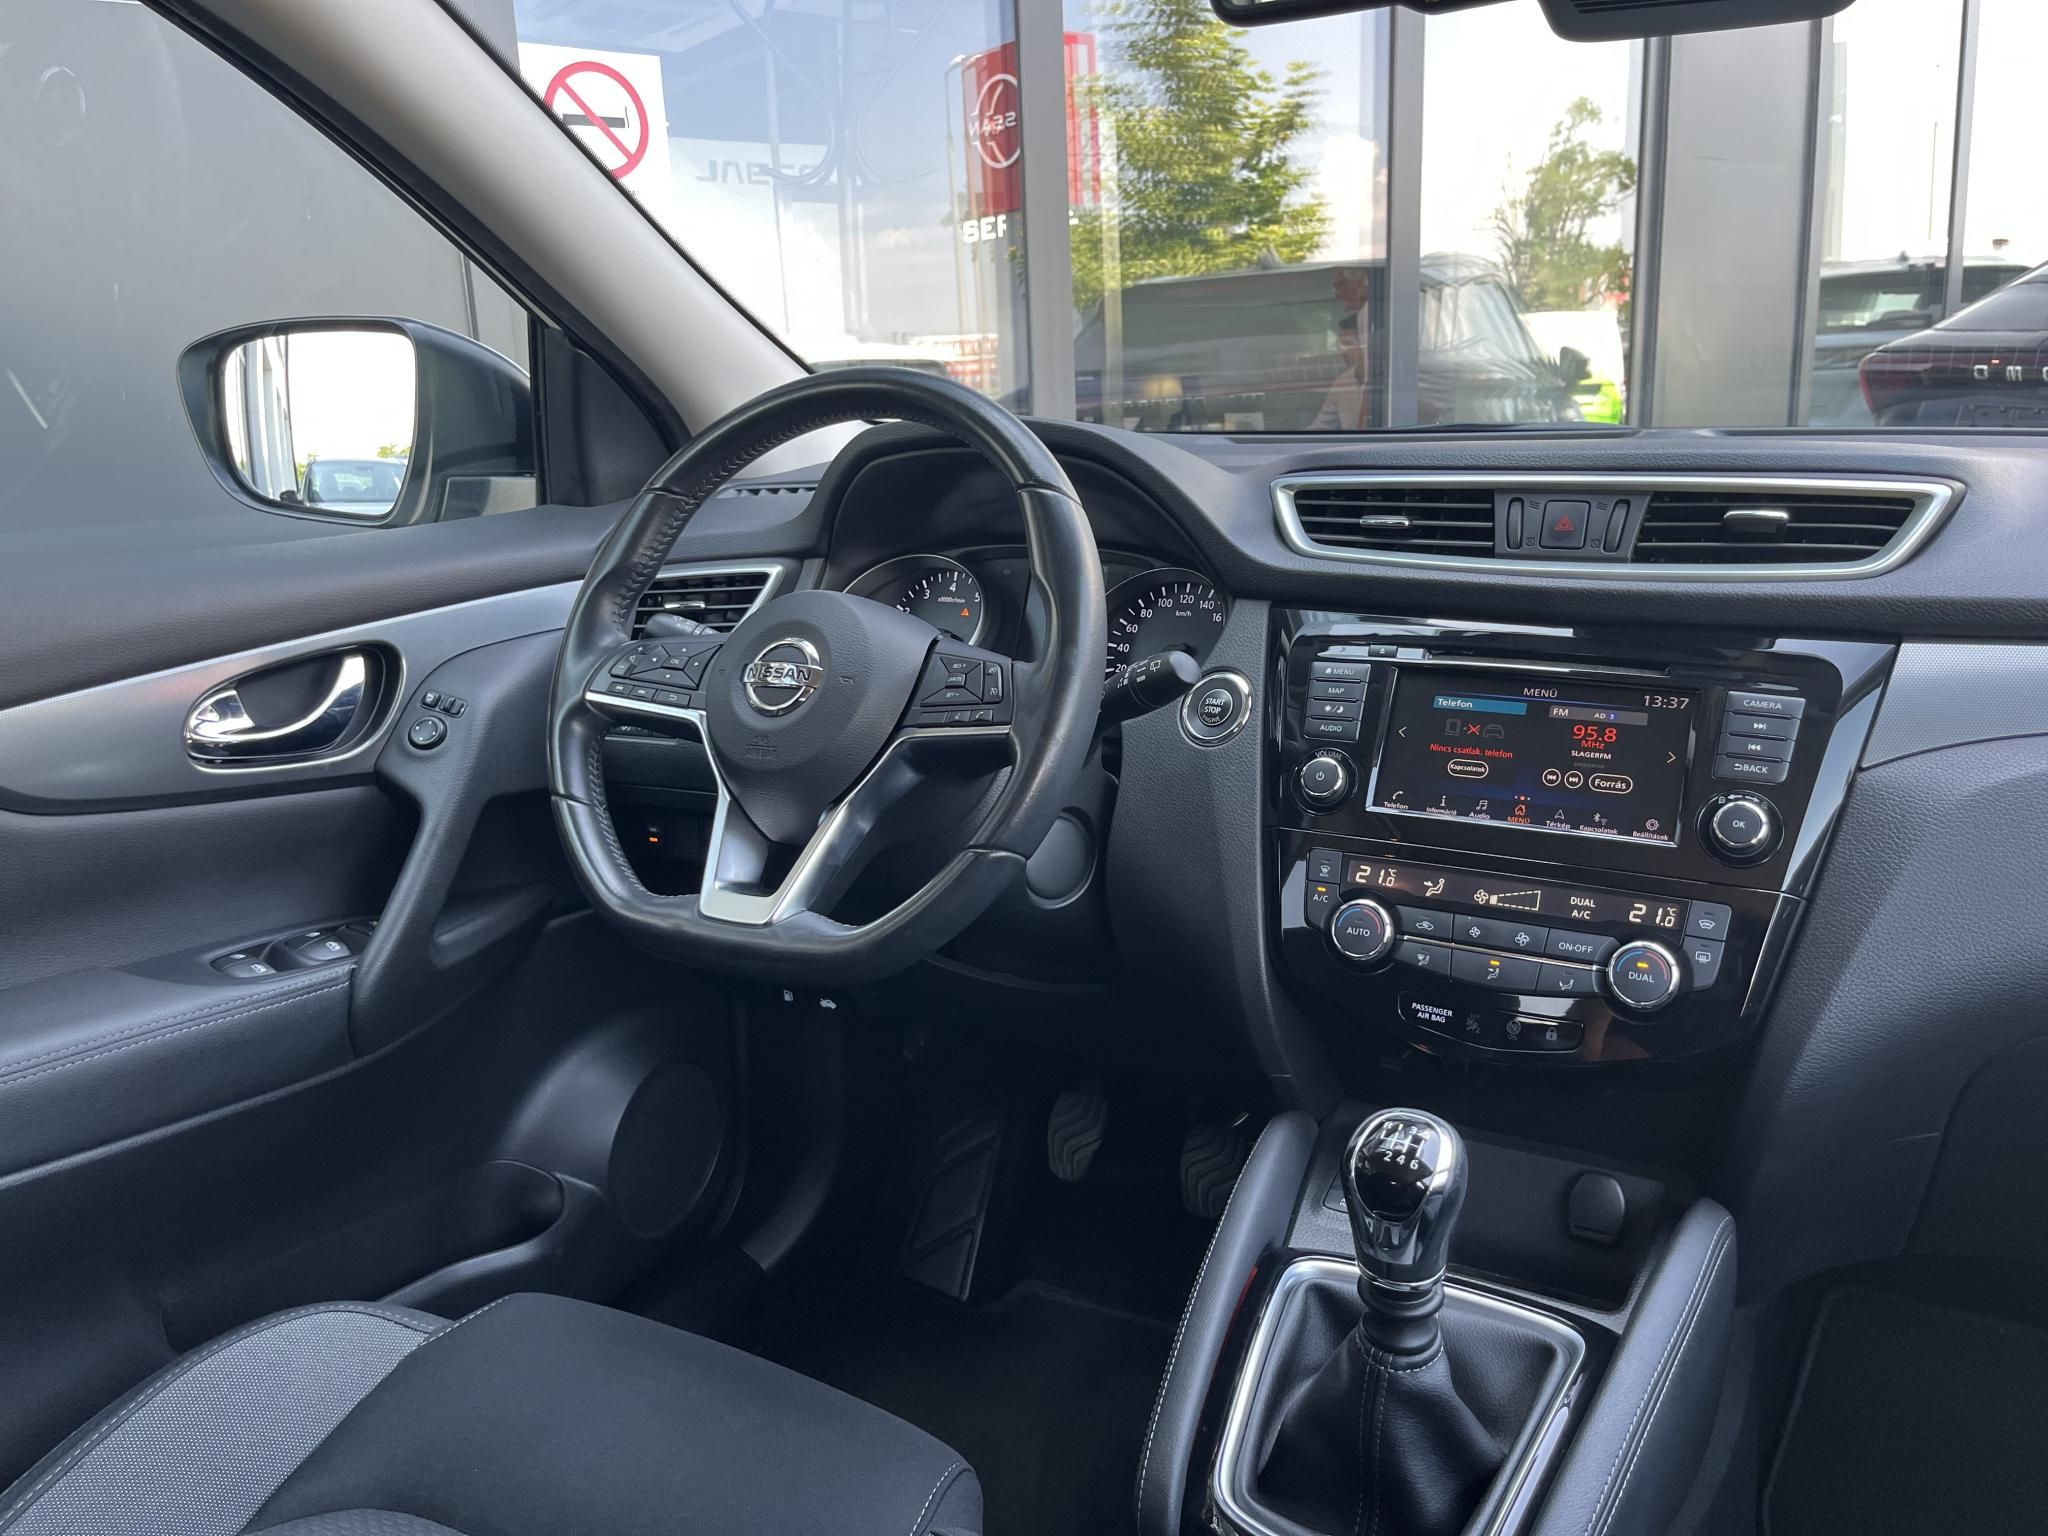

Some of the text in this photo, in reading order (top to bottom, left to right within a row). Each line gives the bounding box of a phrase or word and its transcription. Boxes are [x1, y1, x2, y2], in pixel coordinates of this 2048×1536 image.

[949, 582, 957, 592] 4
[923, 589, 930, 599] 3
[974, 592, 980, 602] 5
[1158, 599, 1173, 608] 100
[1180, 595, 1194, 604] 120
[1200, 600, 1214, 609] 140
[1140, 609, 1153, 618] 80
[1126, 624, 1138, 633] 60
[1117, 643, 1129, 652] 40
[747, 665, 811, 681] NISSAN
[1115, 664, 1127, 673] 20
[1523, 688, 1558, 698] MENÜ
[1205, 698, 1225, 706] START
[1437, 698, 1473, 708] Telefon
[1643, 695, 1690, 709] 13:37
[1743, 699, 1782, 710] CAMERA
[1204, 706, 1221, 714] STOP
[1553, 708, 1569, 717] FM
[1320, 724, 1342, 732] AUDIO
[1573, 724, 1617, 742] 95.8
[1581, 740, 1605, 749] MHz
[1315, 750, 1343, 760] VOLUME
[1429, 743, 1452, 752] Nincs
[1485, 749, 1513, 758] telefon
[1571, 750, 1612, 760] SLAGERFM
[1450, 763, 1486, 773] Kapcsolatok
[1743, 763, 1768, 774] BACK
[1594, 779, 1626, 790] Forrás
[1383, 801, 1408, 810] Telefon
[1469, 811, 1491, 820] Audio
[1545, 820, 1570, 830] Térkép
[1580, 824, 1618, 835] Kapcsolatok
[1732, 820, 1745, 829] OK
[1312, 894, 1329, 903] A/C
[1570, 896, 1596, 908] DUAL
[1571, 909, 1591, 919] A/C
[1346, 926, 1370, 937] AUTO
[1628, 971, 1655, 983] DUAL
[1411, 1002, 1453, 1017] PASSENGER
[1416, 1011, 1446, 1023] AIR BAG
[1409, 1126, 1417, 1134] 3
[1384, 1151, 1418, 1169] 2 4 6
